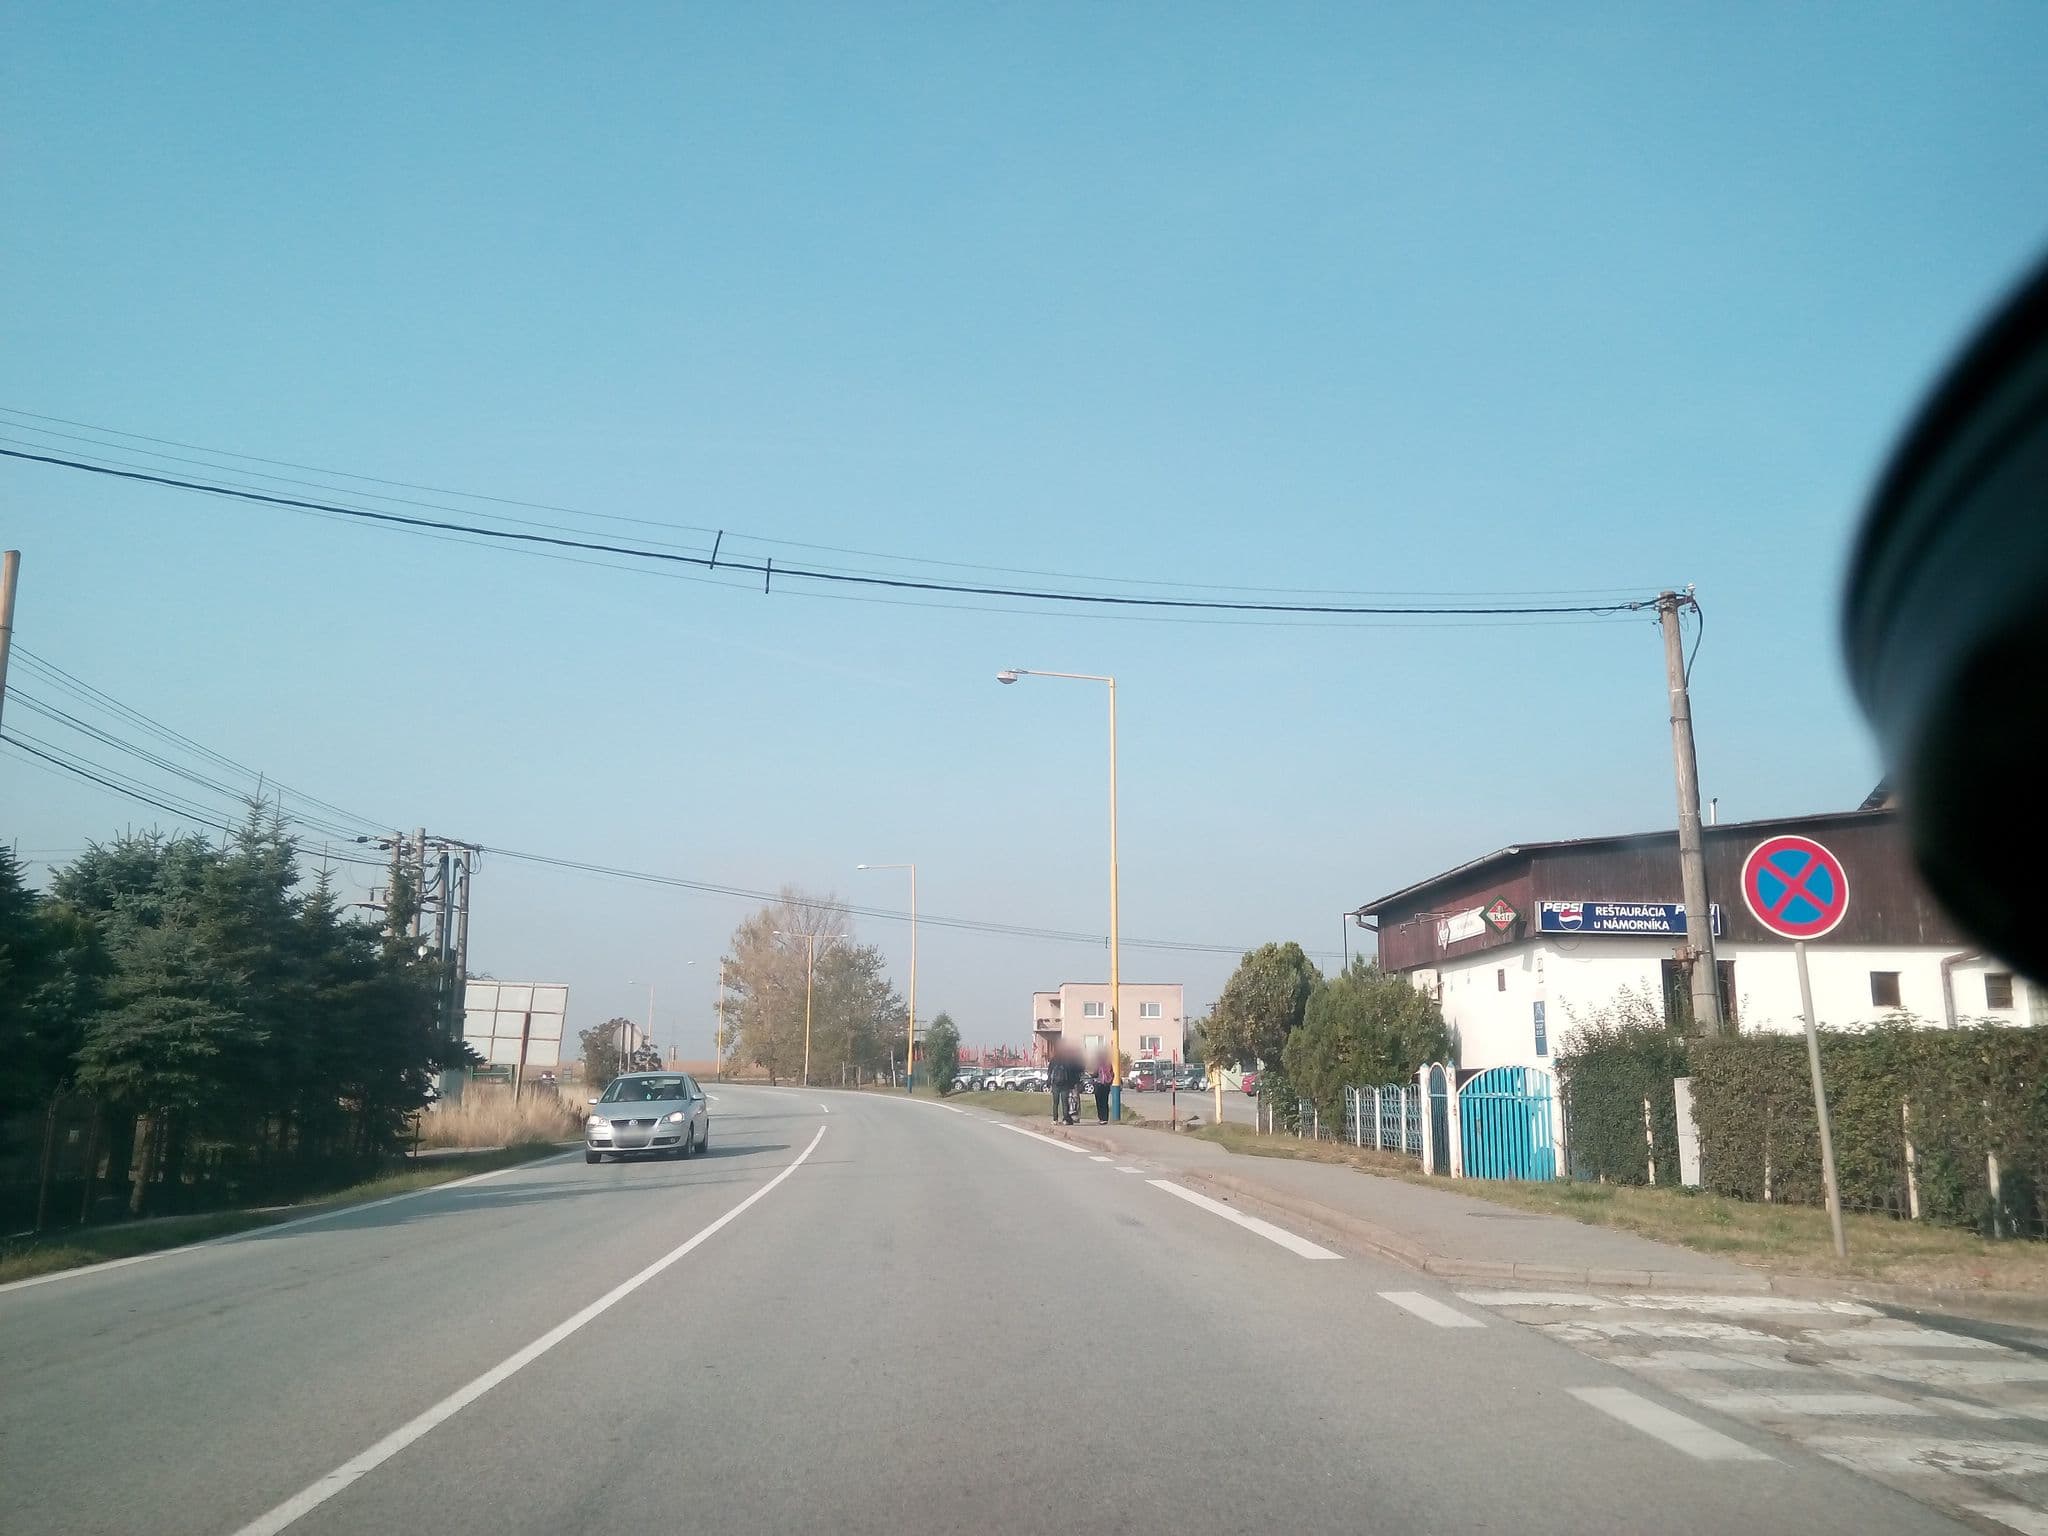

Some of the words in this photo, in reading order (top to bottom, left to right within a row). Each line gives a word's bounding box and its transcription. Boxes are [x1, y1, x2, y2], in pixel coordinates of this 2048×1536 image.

[1543, 902, 1584, 913] PEPSI
[1595, 905, 1666, 917] REŠTAURÁCIA
[1603, 918, 1670, 930] NÁMORNÍKA
